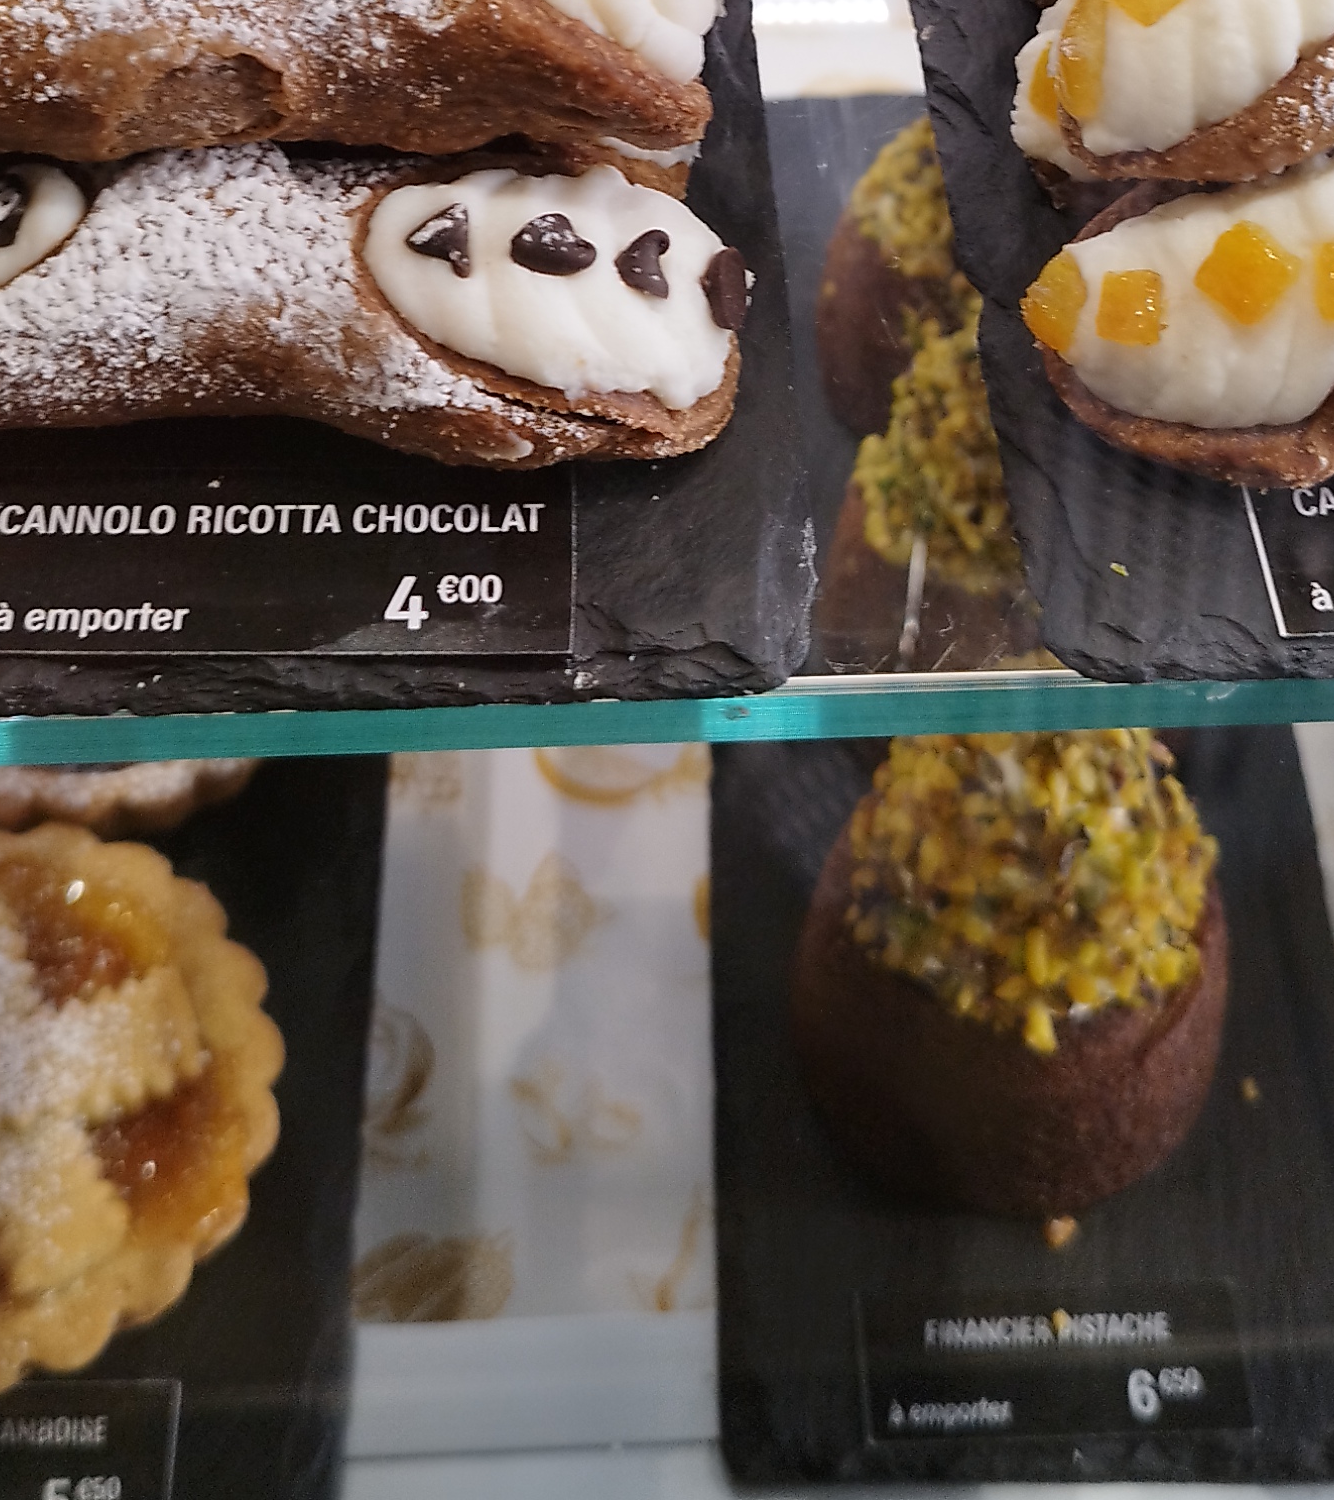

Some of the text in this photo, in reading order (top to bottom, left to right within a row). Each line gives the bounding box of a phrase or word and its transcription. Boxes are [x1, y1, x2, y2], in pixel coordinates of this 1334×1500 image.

[186, 504, 342, 535] RICOTTA
[352, 503, 545, 534] CHOCOLAT
[1310, 581, 1334, 612] à
[24, 603, 189, 639] emporter
